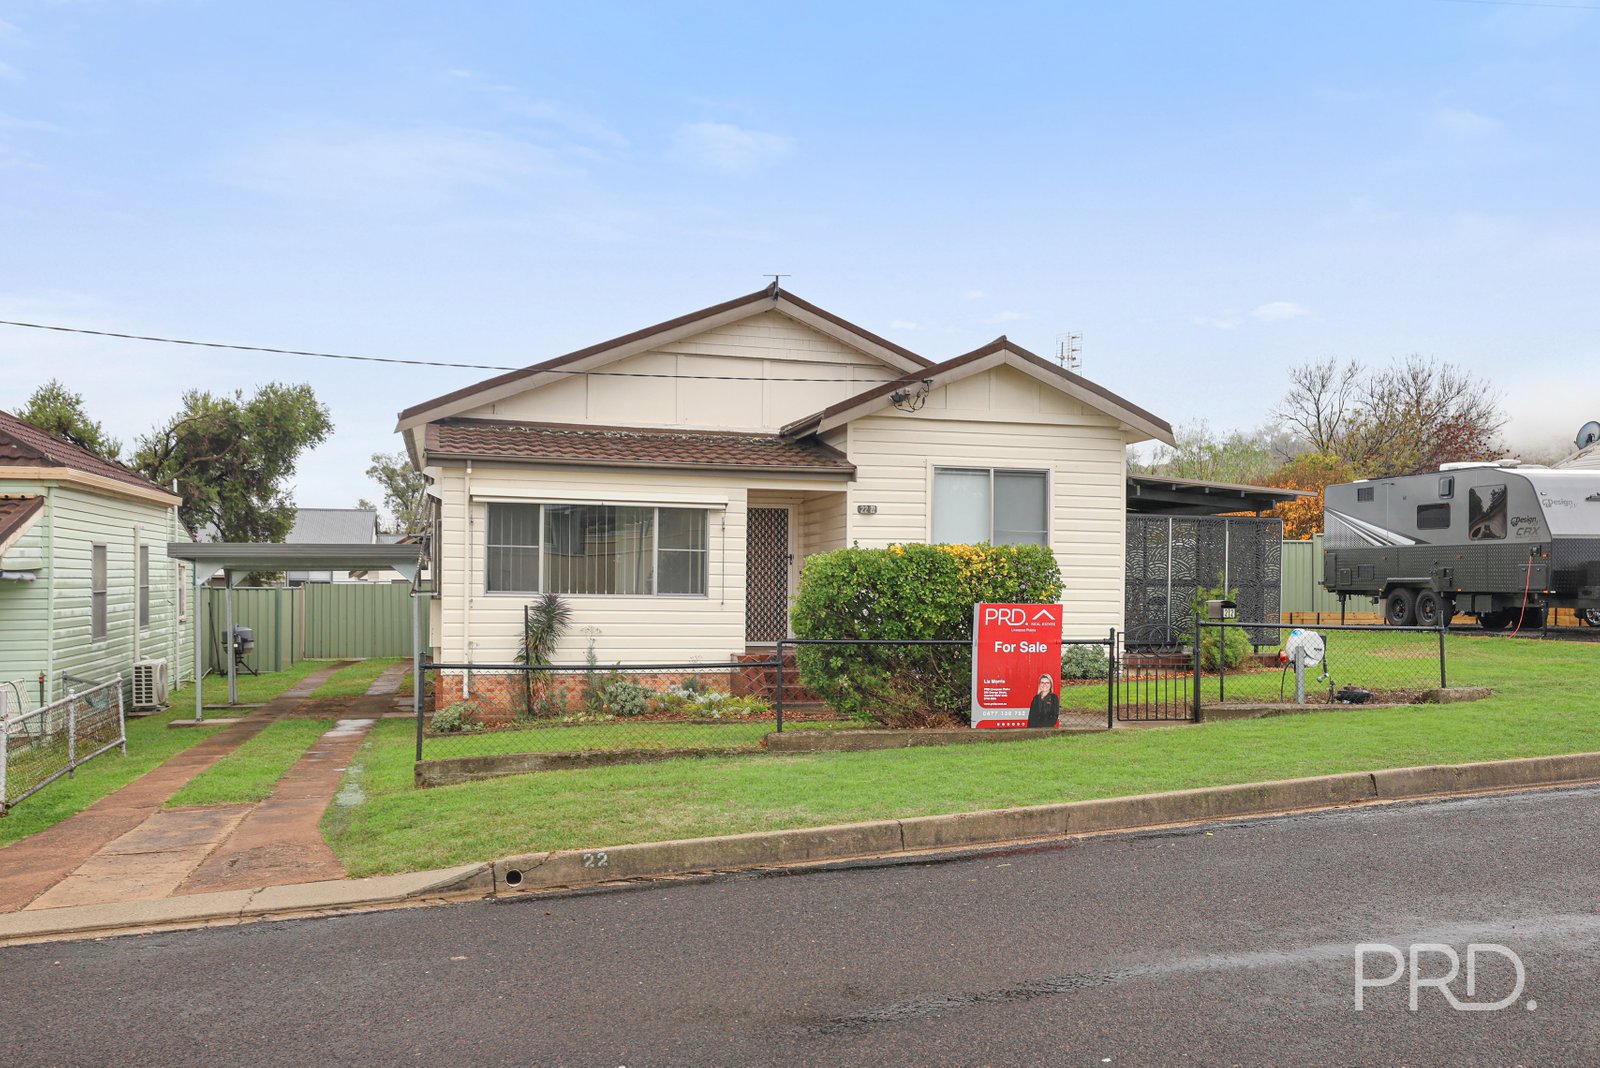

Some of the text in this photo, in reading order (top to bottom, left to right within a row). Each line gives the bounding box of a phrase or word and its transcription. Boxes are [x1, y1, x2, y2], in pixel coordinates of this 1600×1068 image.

[994, 641, 1048, 653] For Sale
[583, 852, 608, 867] 22
